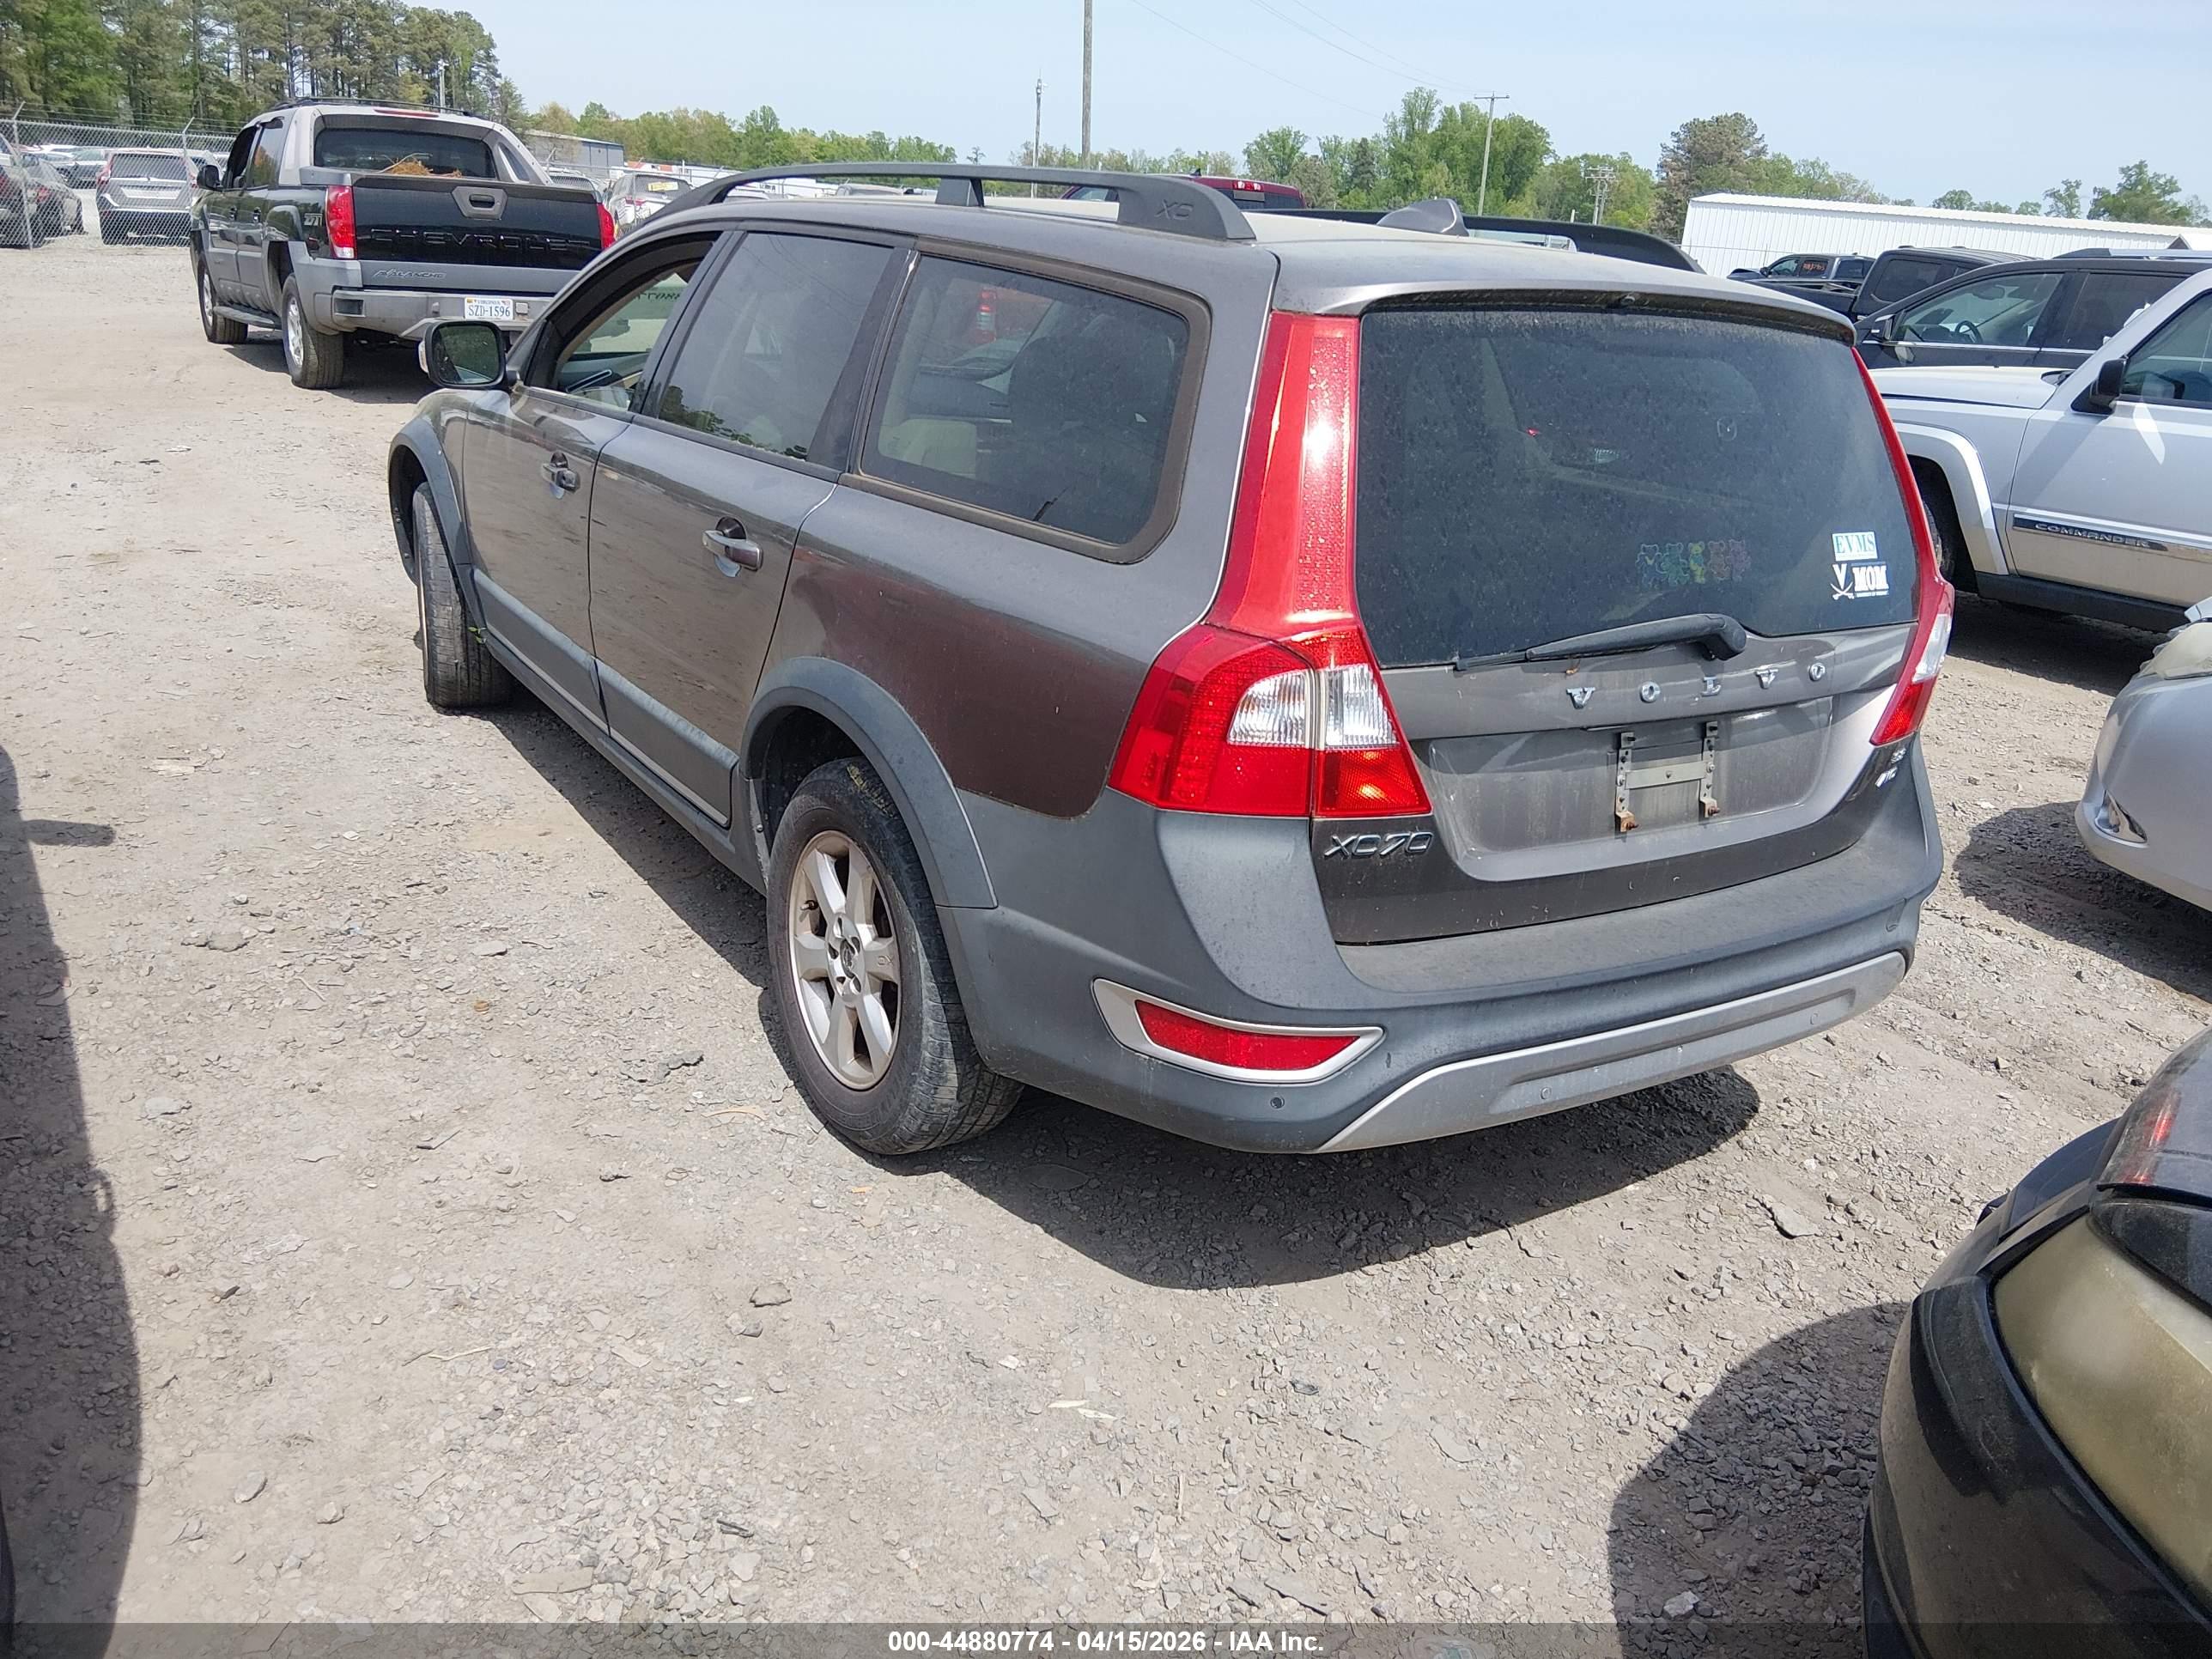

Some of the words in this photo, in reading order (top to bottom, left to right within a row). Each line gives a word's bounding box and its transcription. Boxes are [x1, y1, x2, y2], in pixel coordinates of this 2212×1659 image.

[304, 212, 323, 227] Z71
[1153, 198, 1194, 220] XC
[371, 228, 591, 252] CHEVROLET
[468, 304, 511, 317] SZD-1596
[1834, 533, 1875, 554] EVMS
[2034, 522, 2151, 549] COMMANDER
[1852, 564, 1889, 592] MOM
[1566, 661, 1827, 709] VOLVO
[1323, 830, 1434, 857] XC70
